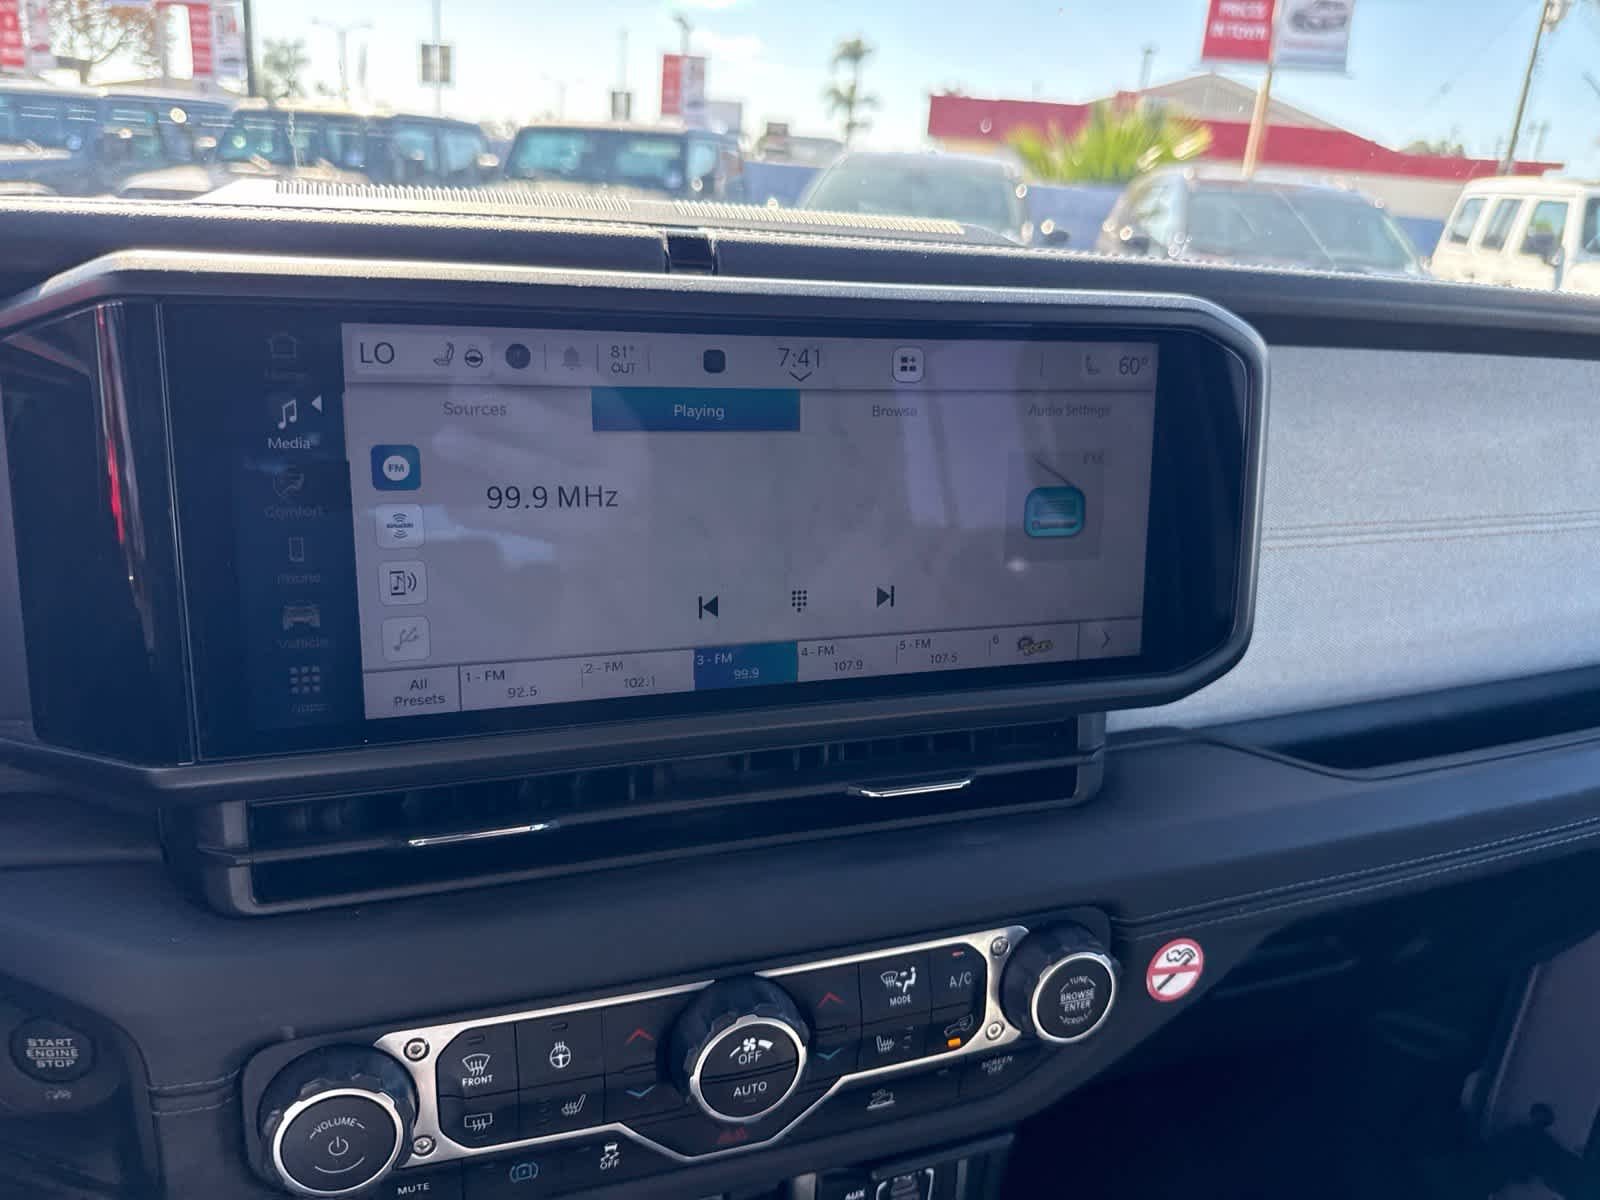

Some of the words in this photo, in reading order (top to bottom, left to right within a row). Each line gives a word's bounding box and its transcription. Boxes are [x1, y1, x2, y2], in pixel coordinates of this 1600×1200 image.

[359, 342, 395, 365] LO
[610, 345, 636, 358] 81°
[777, 347, 822, 369] 7:41
[610, 361, 637, 374] OUT
[1118, 356, 1149, 376] 60°
[443, 401, 507, 417] Sources
[673, 403, 725, 421] Playing
[871, 403, 919, 418] Browse
[267, 436, 311, 450] Media
[388, 462, 405, 473] FM
[486, 485, 549, 510] 99.9
[557, 484, 619, 508] MHz
[900, 640, 906, 650] 5
[916, 638, 931, 649] FM
[801, 647, 809, 657] 4
[818, 645, 835, 657] FM
[697, 655, 704, 666] 3
[715, 654, 733, 666] FM
[930, 653, 958, 665] 107.5
[584, 663, 593, 674] 2
[605, 661, 624, 673] FM
[834, 660, 864, 673] 107.9
[485, 670, 506, 682] FM
[734, 667, 760, 681] 99.9
[410, 679, 428, 690] All
[507, 685, 538, 699] 92.5
[394, 693, 446, 708] Presets
[950, 971, 973, 988] A/C
[889, 994, 912, 1007] MODE
[1060, 988, 1095, 1002] BROWSE
[1064, 999, 1091, 1012] ENTER
[27, 1038, 72, 1047] START
[26, 1047, 80, 1058] ENGINE
[738, 1051, 763, 1065] OFF
[36, 1059, 75, 1069] STOP
[462, 1074, 493, 1087] FRONT
[732, 1081, 768, 1098] AUTO
[315, 1117, 358, 1135] VOLUME
[600, 1158, 621, 1170] OFF
[397, 1182, 431, 1195] MUTE
